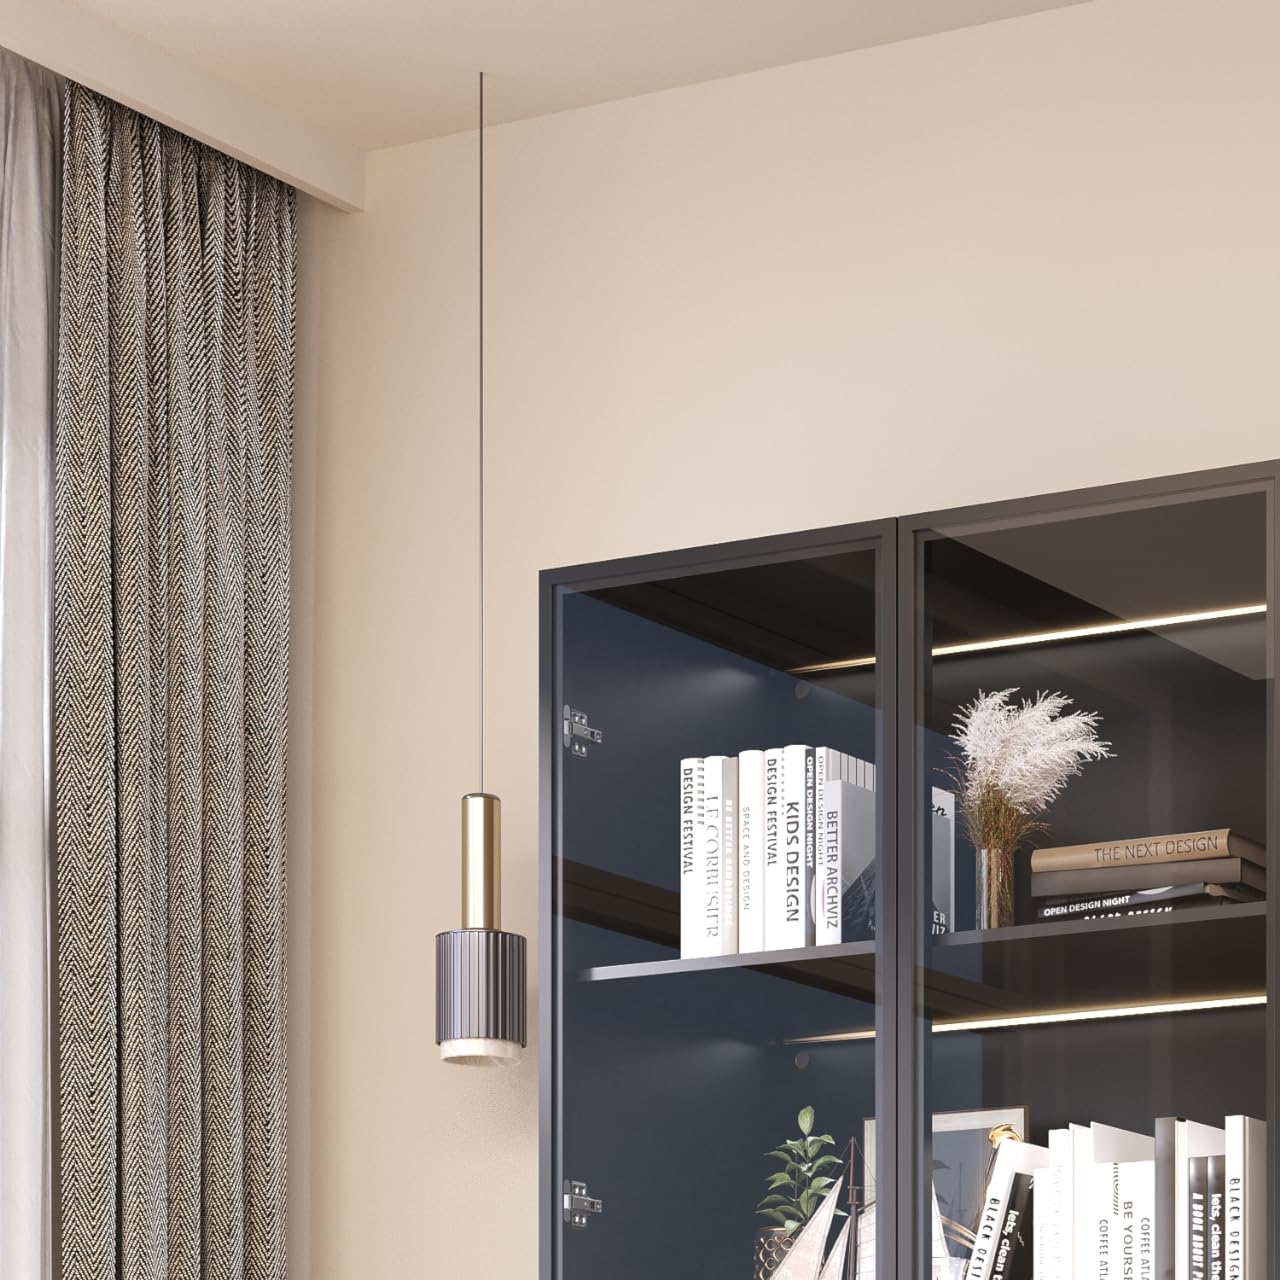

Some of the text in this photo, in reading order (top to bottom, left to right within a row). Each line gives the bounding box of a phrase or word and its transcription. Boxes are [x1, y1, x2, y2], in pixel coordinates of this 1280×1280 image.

[684, 768, 693, 875] DESIGN FESTIVAL
[767, 758, 777, 866] DESIGN FESTIVAL
[786, 802, 799, 922] KIDS DESIGN
[1094, 836, 1218, 863] THE NEXT DESIGN
[827, 811, 838, 929] BETTER ARCHVIZ
[1044, 906, 1067, 917] OPEN
[1069, 901, 1101, 913] DESIGN
[1102, 896, 1130, 907] NIGHT
[980, 1198, 1000, 1240] BLACK
[1124, 1201, 1133, 1219] BE
[1099, 1219, 1108, 1255] COFFEE
[1141, 1217, 1150, 1254] COFFEE
[1211, 1224, 1222, 1258] clean
[1229, 1178, 1240, 1280] BLACK DESIGN
[995, 1239, 1011, 1271] clean
